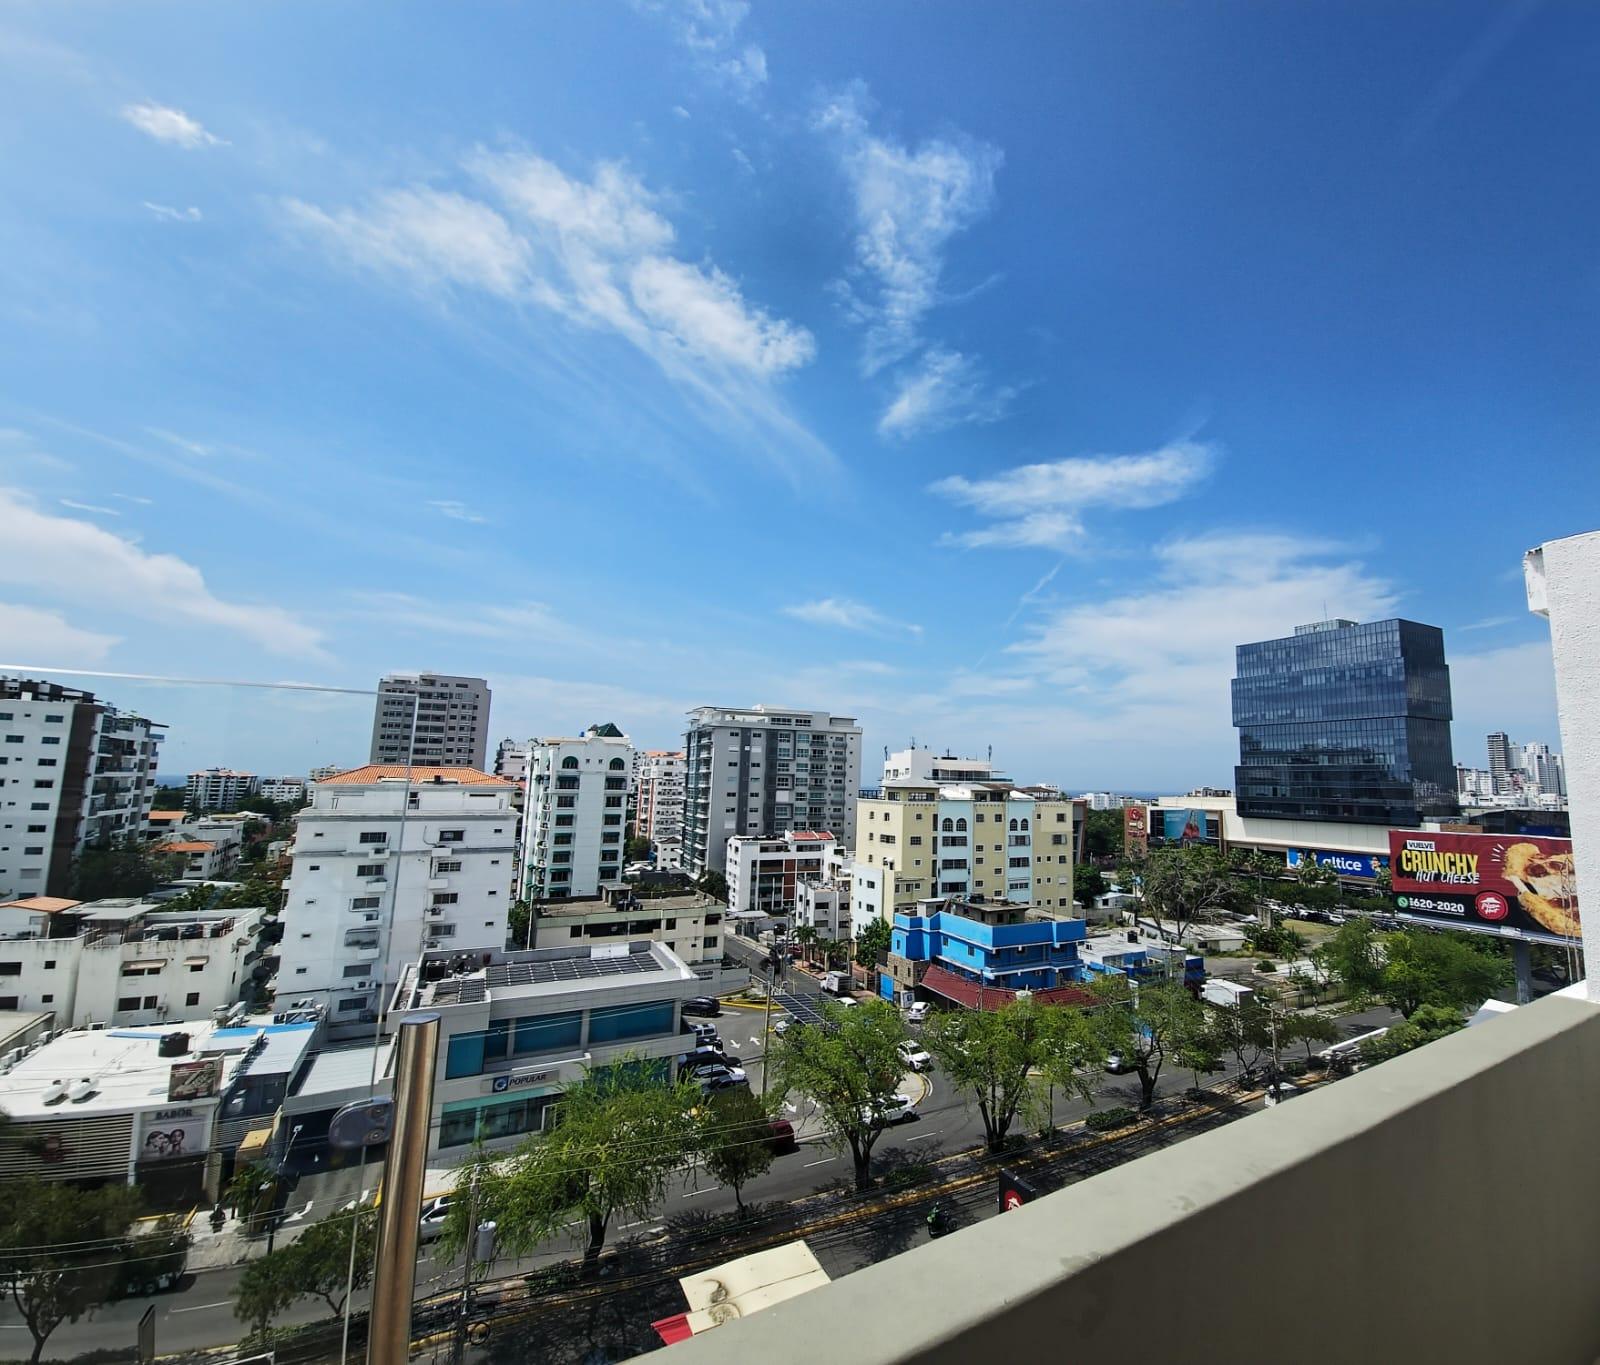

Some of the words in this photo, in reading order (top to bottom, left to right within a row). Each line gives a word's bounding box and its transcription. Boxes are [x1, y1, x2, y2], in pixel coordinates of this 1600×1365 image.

[1401, 849, 1479, 876] CRUNCHY
[1416, 869, 1438, 883] HUT
[1441, 872, 1480, 884] CHEESE
[509, 1074, 546, 1086] POPULAR
